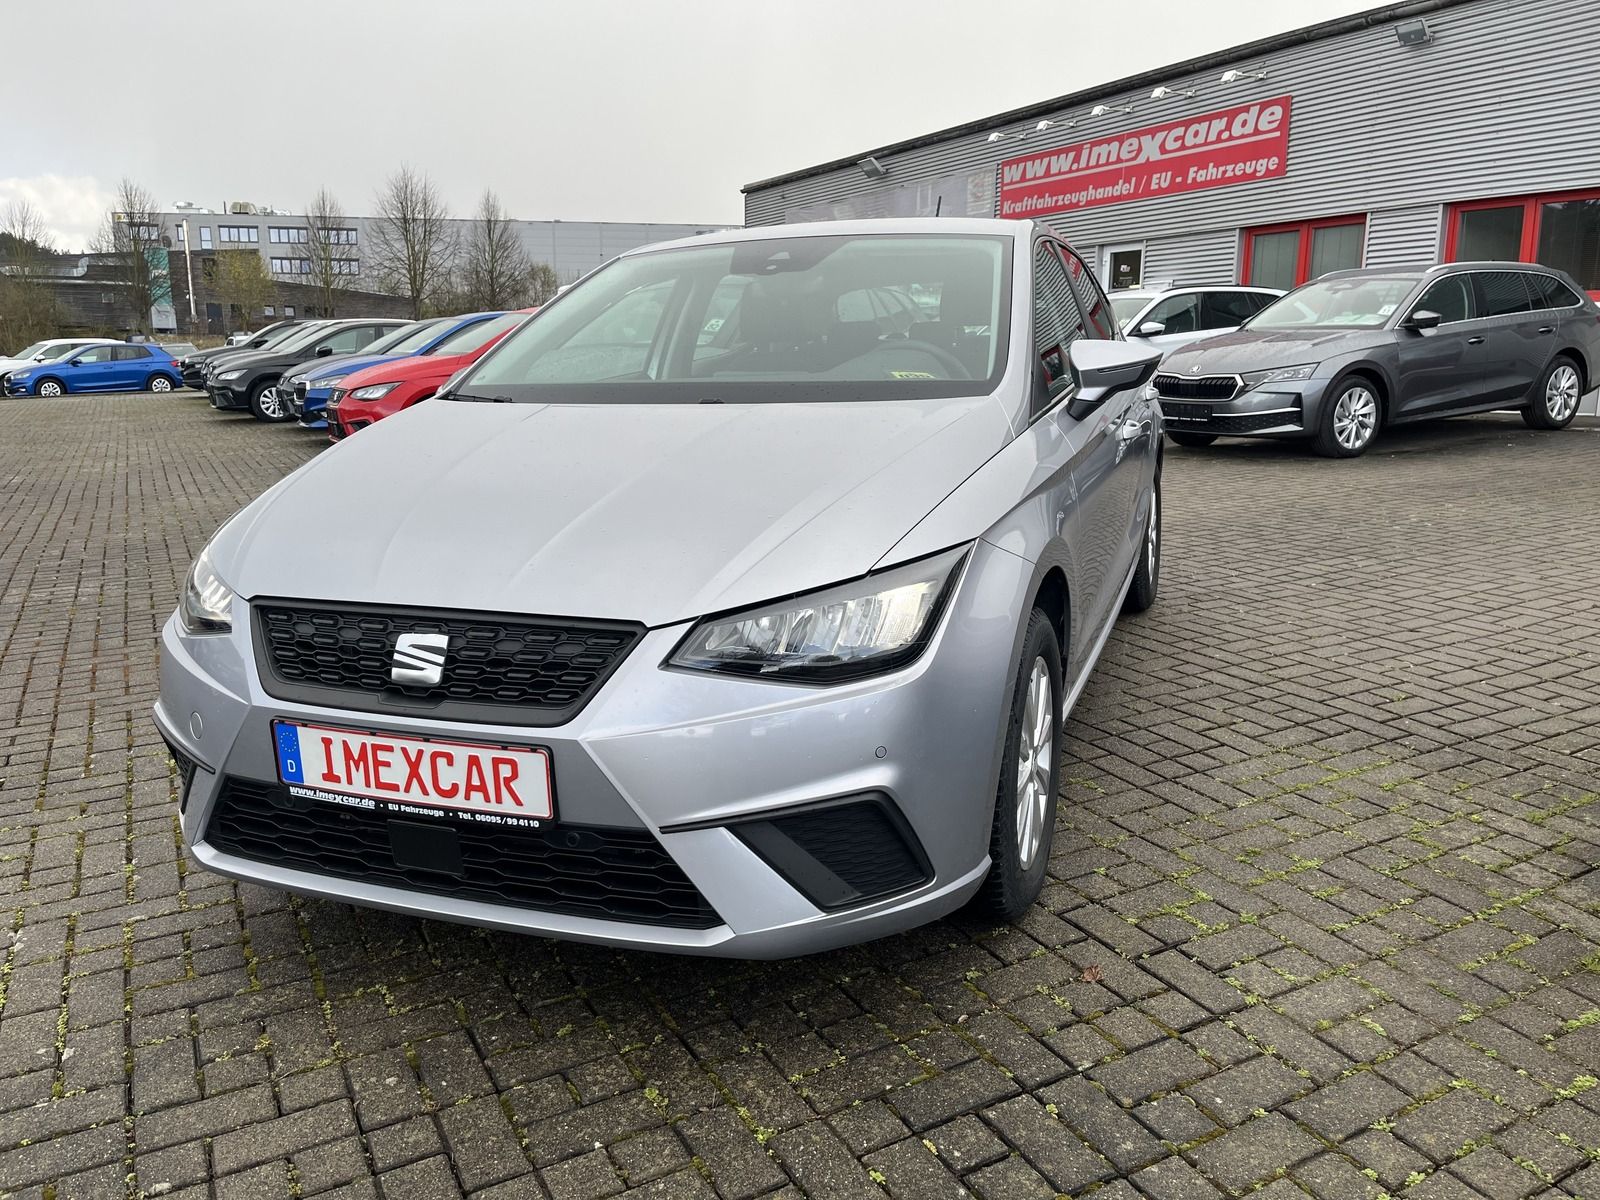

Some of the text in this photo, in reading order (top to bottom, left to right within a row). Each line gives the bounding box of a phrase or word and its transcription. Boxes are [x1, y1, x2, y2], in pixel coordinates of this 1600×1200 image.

[1003, 105, 1283, 184] www.imexcar.de
[1003, 177, 1136, 215] Kraftfahrzeughandel
[1150, 171, 1172, 190] EU
[1187, 156, 1279, 184] Fahrzeuge
[287, 736, 524, 807] D IMEXCAR
[289, 786, 376, 808] www.imexcar.de
[388, 803, 399, 811] EU
[400, 804, 445, 817] Fahrzeuge
[458, 812, 474, 820] Tel.
